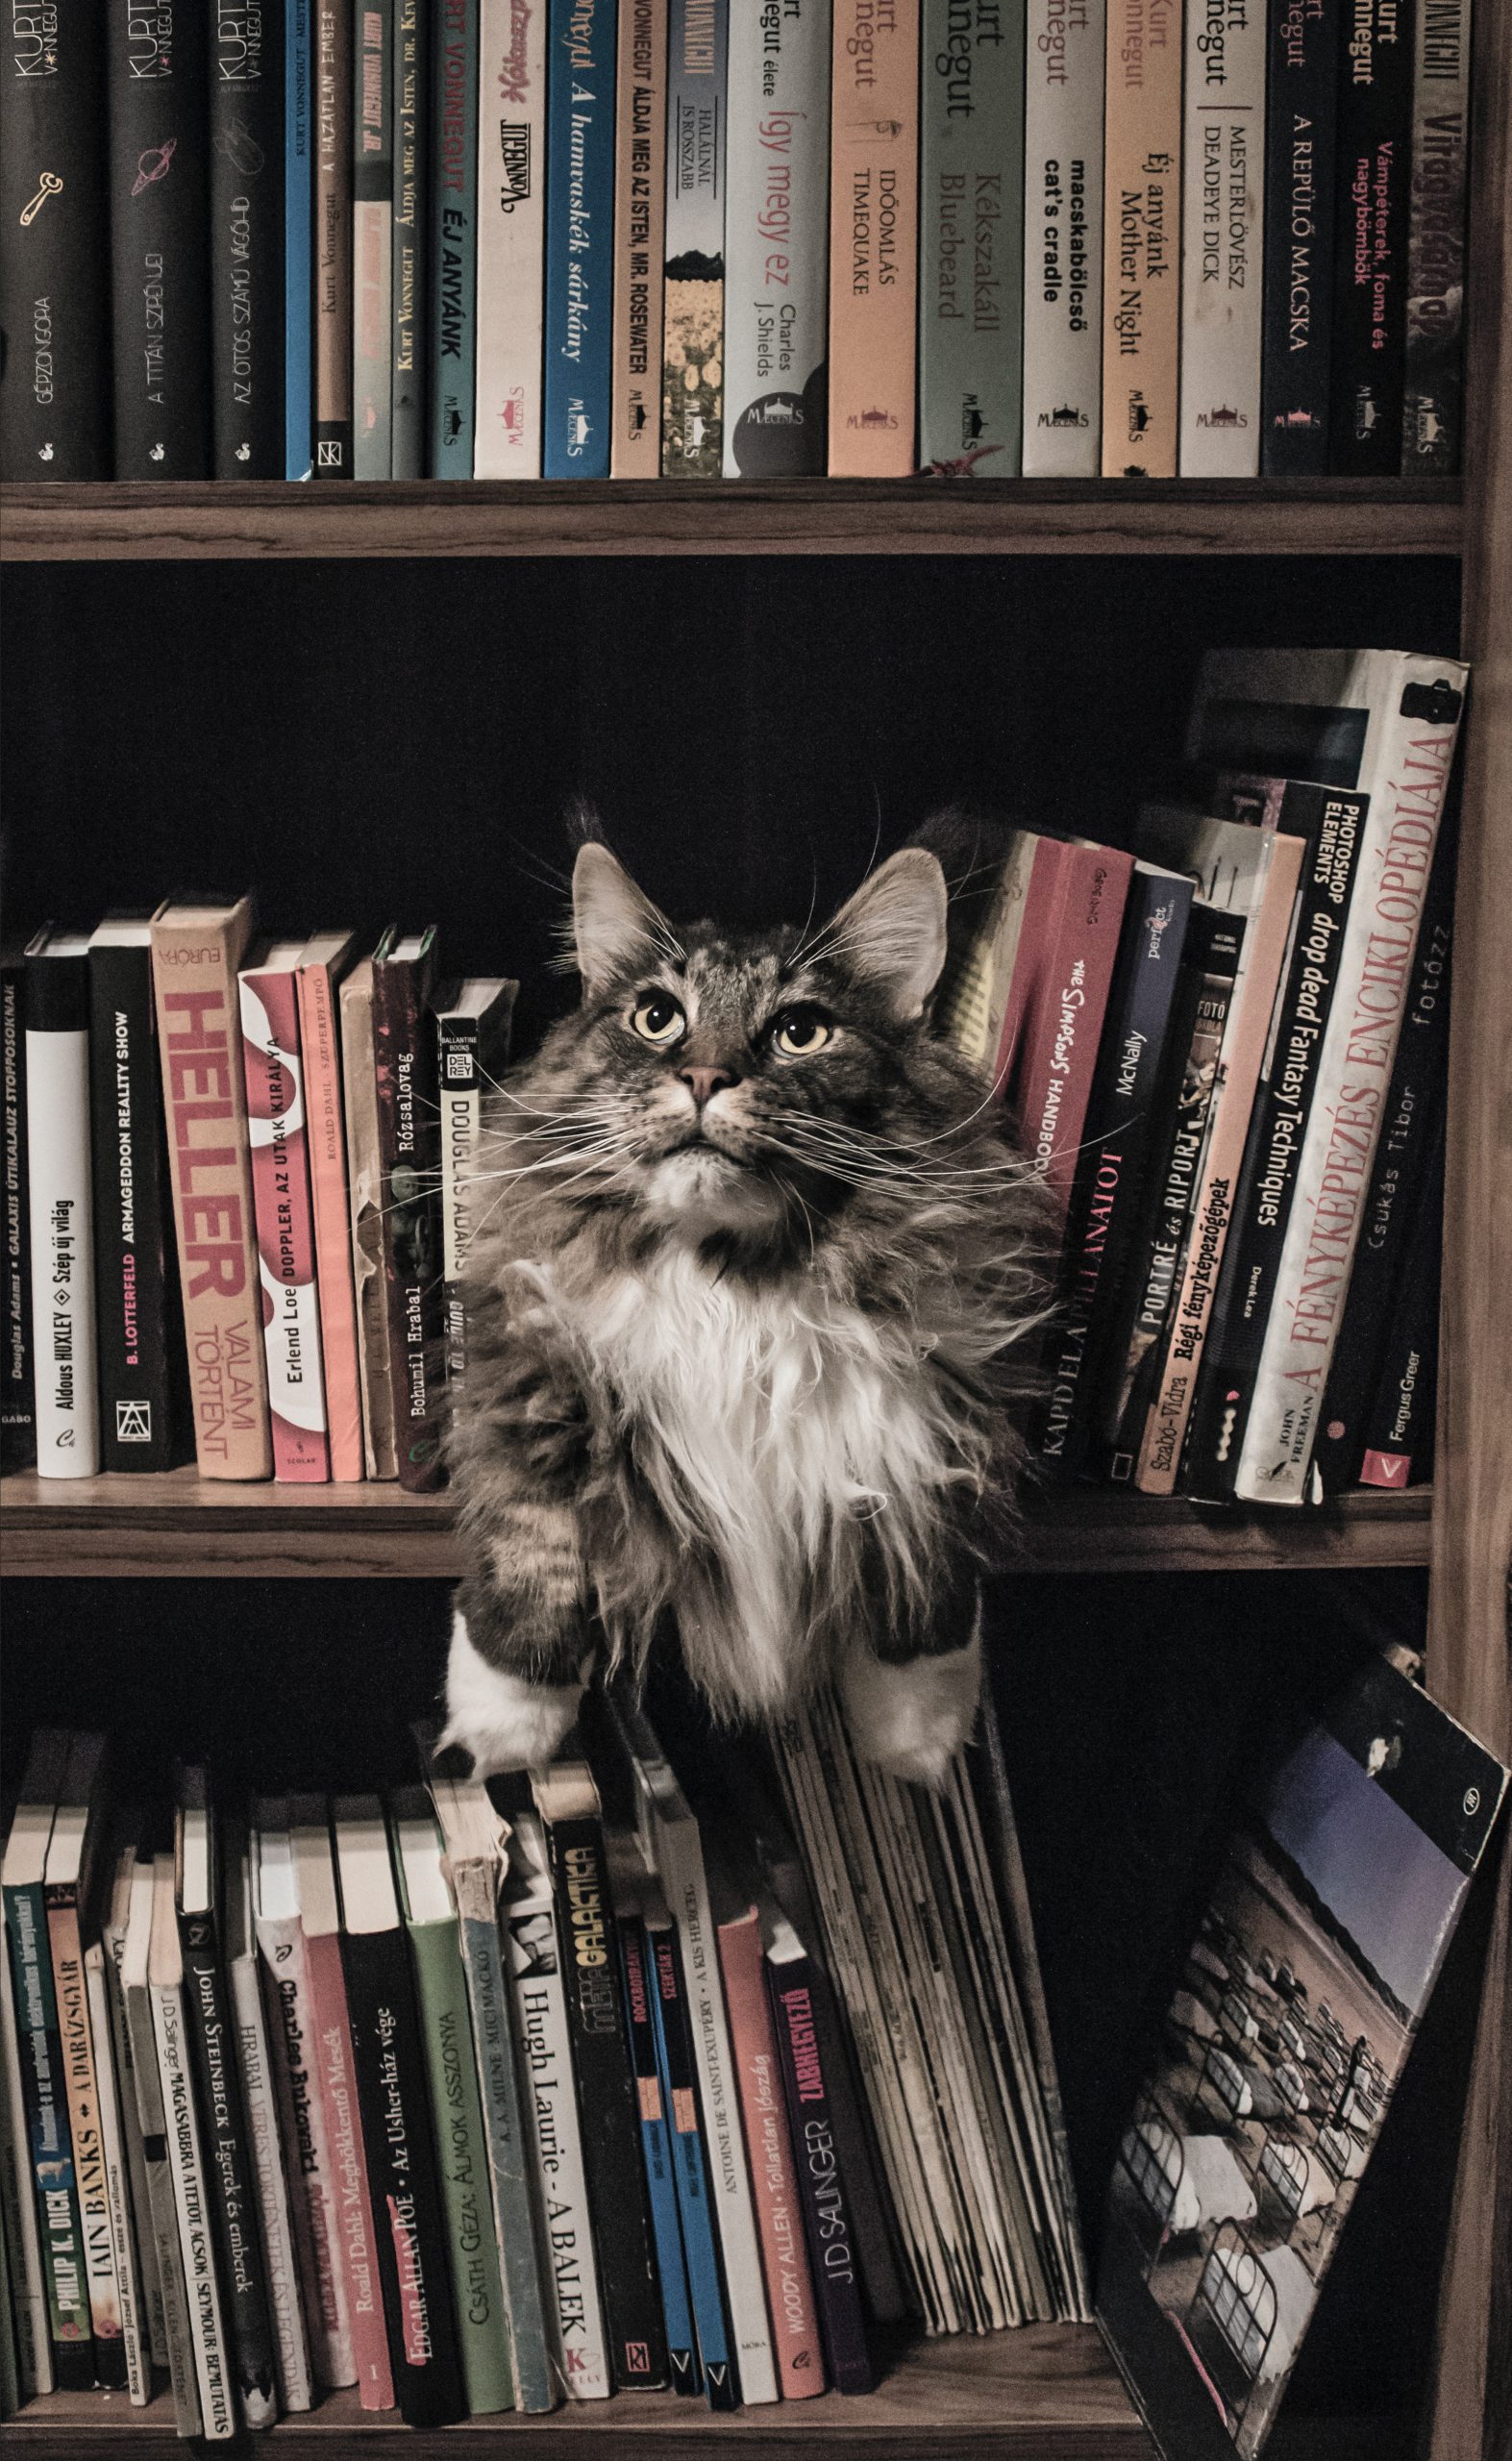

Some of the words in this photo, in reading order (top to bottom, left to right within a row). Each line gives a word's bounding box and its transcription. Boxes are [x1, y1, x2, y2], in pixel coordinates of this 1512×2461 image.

[128, 0, 157, 77] KURT
[218, 0, 246, 80] KURT
[321, 10, 335, 62] EMBER
[363, 12, 381, 50] KURT
[295, 49, 307, 115] VONNEGUT
[363, 53, 381, 127] VONNEGUT
[569, 83, 597, 103] A
[762, 60, 778, 95] élete
[294, 121, 305, 155] KURT
[320, 74, 335, 152] HAZÁTLAN
[441, 41, 464, 192] VONNEGUT
[632, 87, 655, 133] ÁLDJA
[681, 105, 695, 116] IS
[758, 110, 807, 154] Így
[1293, 114, 1312, 131] A
[632, 138, 649, 171] MEG
[681, 120, 695, 188] ROSSZABB
[697, 110, 712, 186] HALÁLNÁL
[1142, 153, 1175, 173] Éj
[1202, 126, 1220, 223] DEADEYE
[566, 113, 594, 253] hamvaskék
[631, 177, 649, 196] AZ
[756, 165, 790, 242] megy
[1044, 159, 1063, 216] cat's
[1227, 126, 1249, 289] MESTERLÖVÉSZ
[1289, 140, 1316, 236] REPÜLŐ
[441, 208, 466, 239] ÉJ
[628, 201, 648, 246] ISTEN,
[850, 167, 870, 295] TIMEQUAKE
[879, 169, 899, 285] IDŐOMLÁS
[937, 172, 965, 318] Bluebeard
[973, 172, 1001, 332] Kékszakáll
[1069, 160, 1087, 331] macskabölcső
[1120, 190, 1142, 281] Mother
[1140, 184, 1170, 279] anyánk
[1350, 158, 1372, 285] nagybömbök
[630, 252, 648, 279] MR.
[764, 254, 788, 286] ez
[1043, 226, 1062, 303] cradle
[1202, 230, 1219, 282] DICK
[320, 275, 336, 312] Kurt
[439, 248, 466, 359] ANYÁNK
[559, 261, 589, 362] sárkány
[1113, 289, 1142, 356] Night
[1288, 245, 1309, 351] MACSKA
[1373, 272, 1391, 320] foma
[33, 296, 52, 403] GÉPZONGORA
[144, 334, 163, 384] TITÁN
[628, 285, 647, 374] ROSEWATER
[756, 317, 774, 377] Shields
[777, 304, 796, 370] Charles
[1370, 328, 1390, 349] és
[148, 391, 163, 403] A
[234, 381, 250, 404] AZ
[1312, 800, 1342, 884] ELEMENTS
[1327, 803, 1359, 905] PHOTOSHOP
[1342, 728, 1453, 1068] ENCIKLOPÉDIÁJA
[1299, 910, 1339, 965] drop
[1294, 965, 1329, 1022] dead
[1410, 923, 1450, 1027] fotózz
[114, 1010, 129, 1058] SHOW
[1198, 1001, 1226, 1019] FOTÓ
[262, 1036, 284, 1112] KIRÁLYA
[448, 1056, 471, 1064] DEL
[448, 1066, 472, 1077] REY
[1114, 1029, 1149, 1096] McNally
[1273, 1023, 1319, 1107] Fantasy
[116, 1062, 131, 1128] REALITY
[393, 1053, 417, 1150] Rózsalovag
[164, 989, 246, 1301] HELLER
[271, 1119, 288, 1165] UTAK
[451, 1101, 471, 1195] DOUGLAS
[1163, 1128, 1201, 1210] RIPORT
[1250, 1106, 1303, 1230] Techniques
[1367, 1165, 1400, 1251] Csukás
[1387, 1084, 1417, 1152] Tibor
[51, 1199, 73, 1230] világ
[118, 1131, 135, 1243] ARMAGEDDON
[274, 1173, 290, 1194] AZ
[1284, 1080, 1380, 1348] FÉNYKÉPEZÉS
[8, 1195, 19, 1255] GALAXIS
[53, 1235, 74, 1247] új
[277, 1199, 298, 1278] DOPPLER,
[453, 1202, 472, 1271] ADAMS
[1165, 1215, 1183, 1236] és
[1181, 1176, 1232, 1320] fényképezőgépek
[9, 1274, 21, 1320] Adams
[52, 1252, 76, 1281] Szép
[1138, 1238, 1179, 1326] PORTRÉ
[1246, 1265, 1262, 1298] Derek
[122, 1254, 137, 1345] LOTTERFELD
[281, 1288, 299, 1320] Loe
[405, 1285, 424, 1342] Hrabal
[1242, 1298, 1256, 1319] Lea
[10, 1325, 25, 1379] Douglas
[53, 1311, 72, 1359] HUXLEY
[125, 1350, 138, 1364] B.
[283, 1327, 304, 1383] Erlend
[1055, 1345, 1084, 1380] EL
[1063, 1322, 1088, 1341] A
[1173, 1320, 1204, 1362] Régi
[54, 1365, 73, 1408] Aldous
[193, 1323, 234, 1461] TÖRTÉNT
[222, 1319, 257, 1431] VALAMI
[408, 1353, 427, 1416] Bohumil
[1284, 1360, 1323, 1391] A
[1400, 1350, 1420, 1392] Greer
[1041, 1381, 1078, 1456] KAPD
[1151, 1374, 1188, 1472] Szabó-Vidra
[1281, 1407, 1296, 1447] JOHN
[1289, 1394, 1314, 1463] FREEMAN
[691, 1946, 706, 1968] KIS
[694, 1969, 708, 1981] A
[58, 1958, 90, 2076] DARÁZSGYÁR
[193, 1965, 218, 2017] JOHN
[278, 1978, 306, 2066] Charles
[321, 2026, 346, 2084] Mesék
[372, 2006, 397, 2047] vége
[518, 1989, 557, 2071] Hugh
[696, 1998, 724, 2106] SAINT-EXUPÉRY
[781, 1987, 826, 2102] ZABHEGYEZŐ
[75, 2079, 92, 2093] A
[203, 2022, 232, 2128] STEINBECK
[239, 2025, 263, 2096] HRABAL
[750, 2053, 778, 2112] jószág
[169, 2071, 195, 2169] MAGASABBRA
[377, 2051, 405, 2143] Usher-ház
[533, 2078, 567, 2173] Laurie
[713, 2108, 728, 2127] DE
[75, 2127, 107, 2216] BANKS
[214, 2139, 241, 2197] Egerek
[390, 2147, 409, 2172] Az
[716, 2131, 737, 2195] ANTOINE
[759, 2117, 785, 2191] Tollatlan
[804, 2117, 846, 2238] SALINGER
[44, 2188, 72, 2229] DICK
[226, 2200, 244, 2218] és
[343, 2209, 368, 2258] Dahl:
[545, 2195, 573, 2222] A
[772, 2206, 796, 2265] ALLEN
[49, 2232, 75, 2252] K.
[86, 2223, 114, 2277] IAIN
[227, 2221, 254, 2294] emberek
[52, 2255, 82, 2312] PHILIP
[350, 2263, 375, 2312] Roald
[549, 2227, 585, 2336] BALEK
[780, 2268, 805, 2333] WOODY
